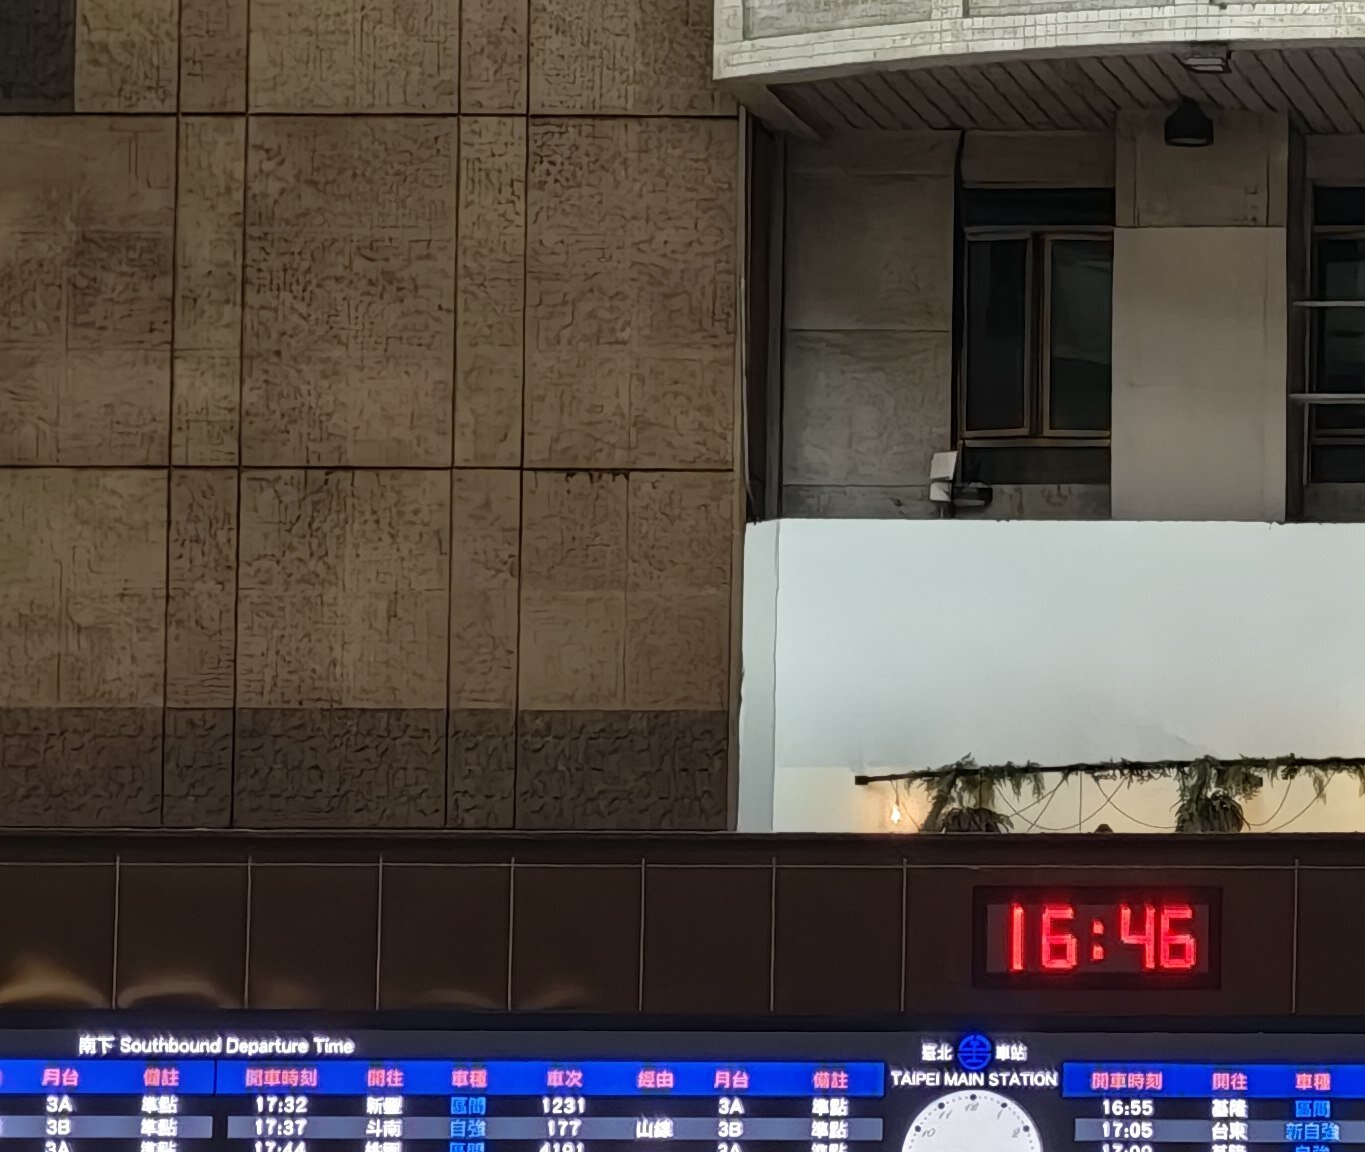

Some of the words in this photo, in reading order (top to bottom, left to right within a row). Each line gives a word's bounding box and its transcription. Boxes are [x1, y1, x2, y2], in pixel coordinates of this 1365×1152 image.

[1009, 903, 1197, 971] 16:46
[79, 1035, 115, 1055] 南下
[120, 1036, 222, 1054] Southbound
[226, 1036, 310, 1057] Departure
[313, 1036, 356, 1055] Time
[42, 1068, 79, 1087] 月台
[245, 1068, 318, 1087] 開車時刻
[547, 1069, 583, 1088] 車次
[637, 1069, 674, 1089] 經由
[714, 1070, 749, 1089] 月台
[890, 1070, 941, 1087] TAIPEI
[943, 1071, 985, 1087] MAIN
[988, 1070, 1059, 1087] STATION
[1091, 1071, 1163, 1090] 開車時刻
[1212, 1072, 1248, 1091] 開往
[46, 1095, 73, 1113] 3A
[256, 1096, 307, 1113] 17:32
[542, 1097, 585, 1114] 1231
[718, 1097, 744, 1115] 3A
[1102, 1099, 1153, 1116] 16:55
[46, 1118, 71, 1136] 3B
[255, 1118, 308, 1136] 17:37
[366, 1120, 401, 1137] 斗南
[547, 1119, 582, 1137] 177
[718, 1120, 744, 1138] 3B
[1102, 1121, 1153, 1139] 17:05
